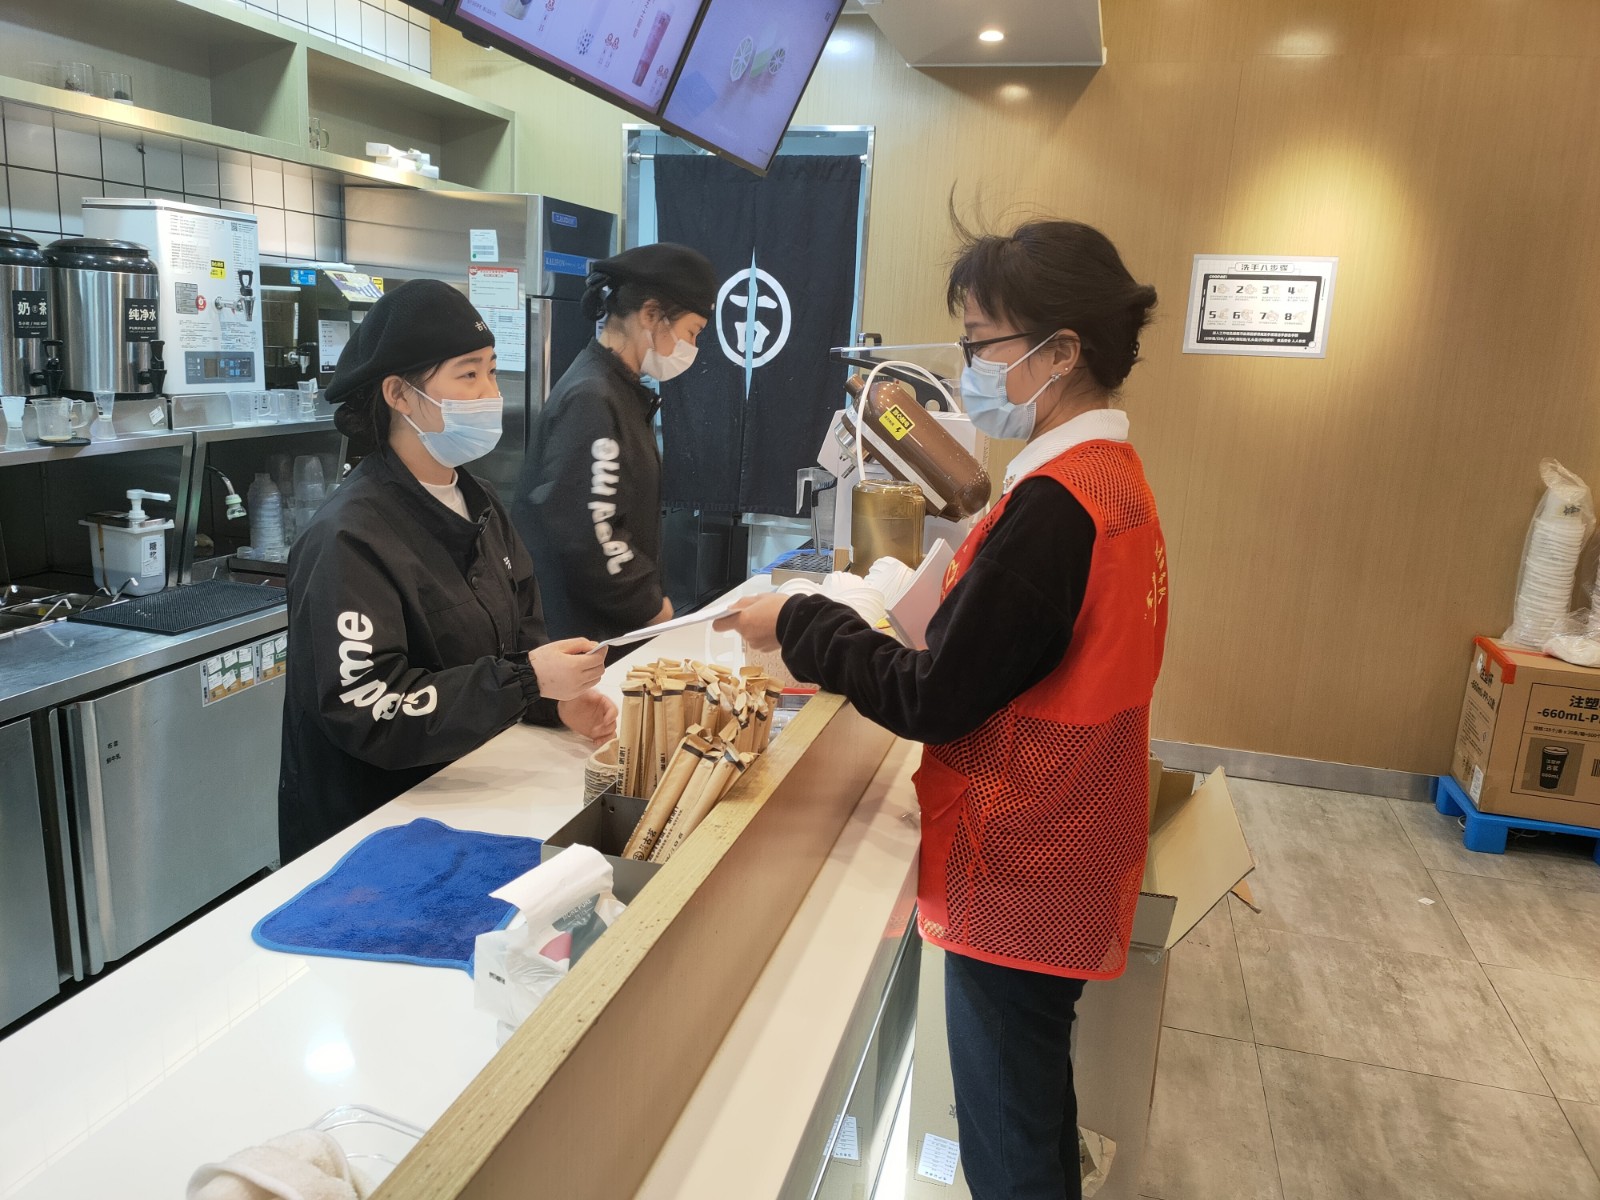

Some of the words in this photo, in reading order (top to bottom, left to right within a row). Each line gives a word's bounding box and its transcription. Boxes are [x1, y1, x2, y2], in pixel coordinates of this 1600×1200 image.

[1212, 285, 1217, 293] 1
[1236, 286, 1244, 294] 2
[1262, 286, 1270, 294] 3
[1287, 286, 1296, 295] 4
[128, 308, 157, 321] 纯净水
[1209, 311, 1217, 319] 5
[1233, 311, 1241, 319] 6
[1259, 312, 1267, 320] 7
[1284, 312, 1292, 320] 8
[1569, 694, 1600, 710] 注塑
[1537, 708, 1600, 724] -660mL-P
[643, 828, 657, 845] 古茗
